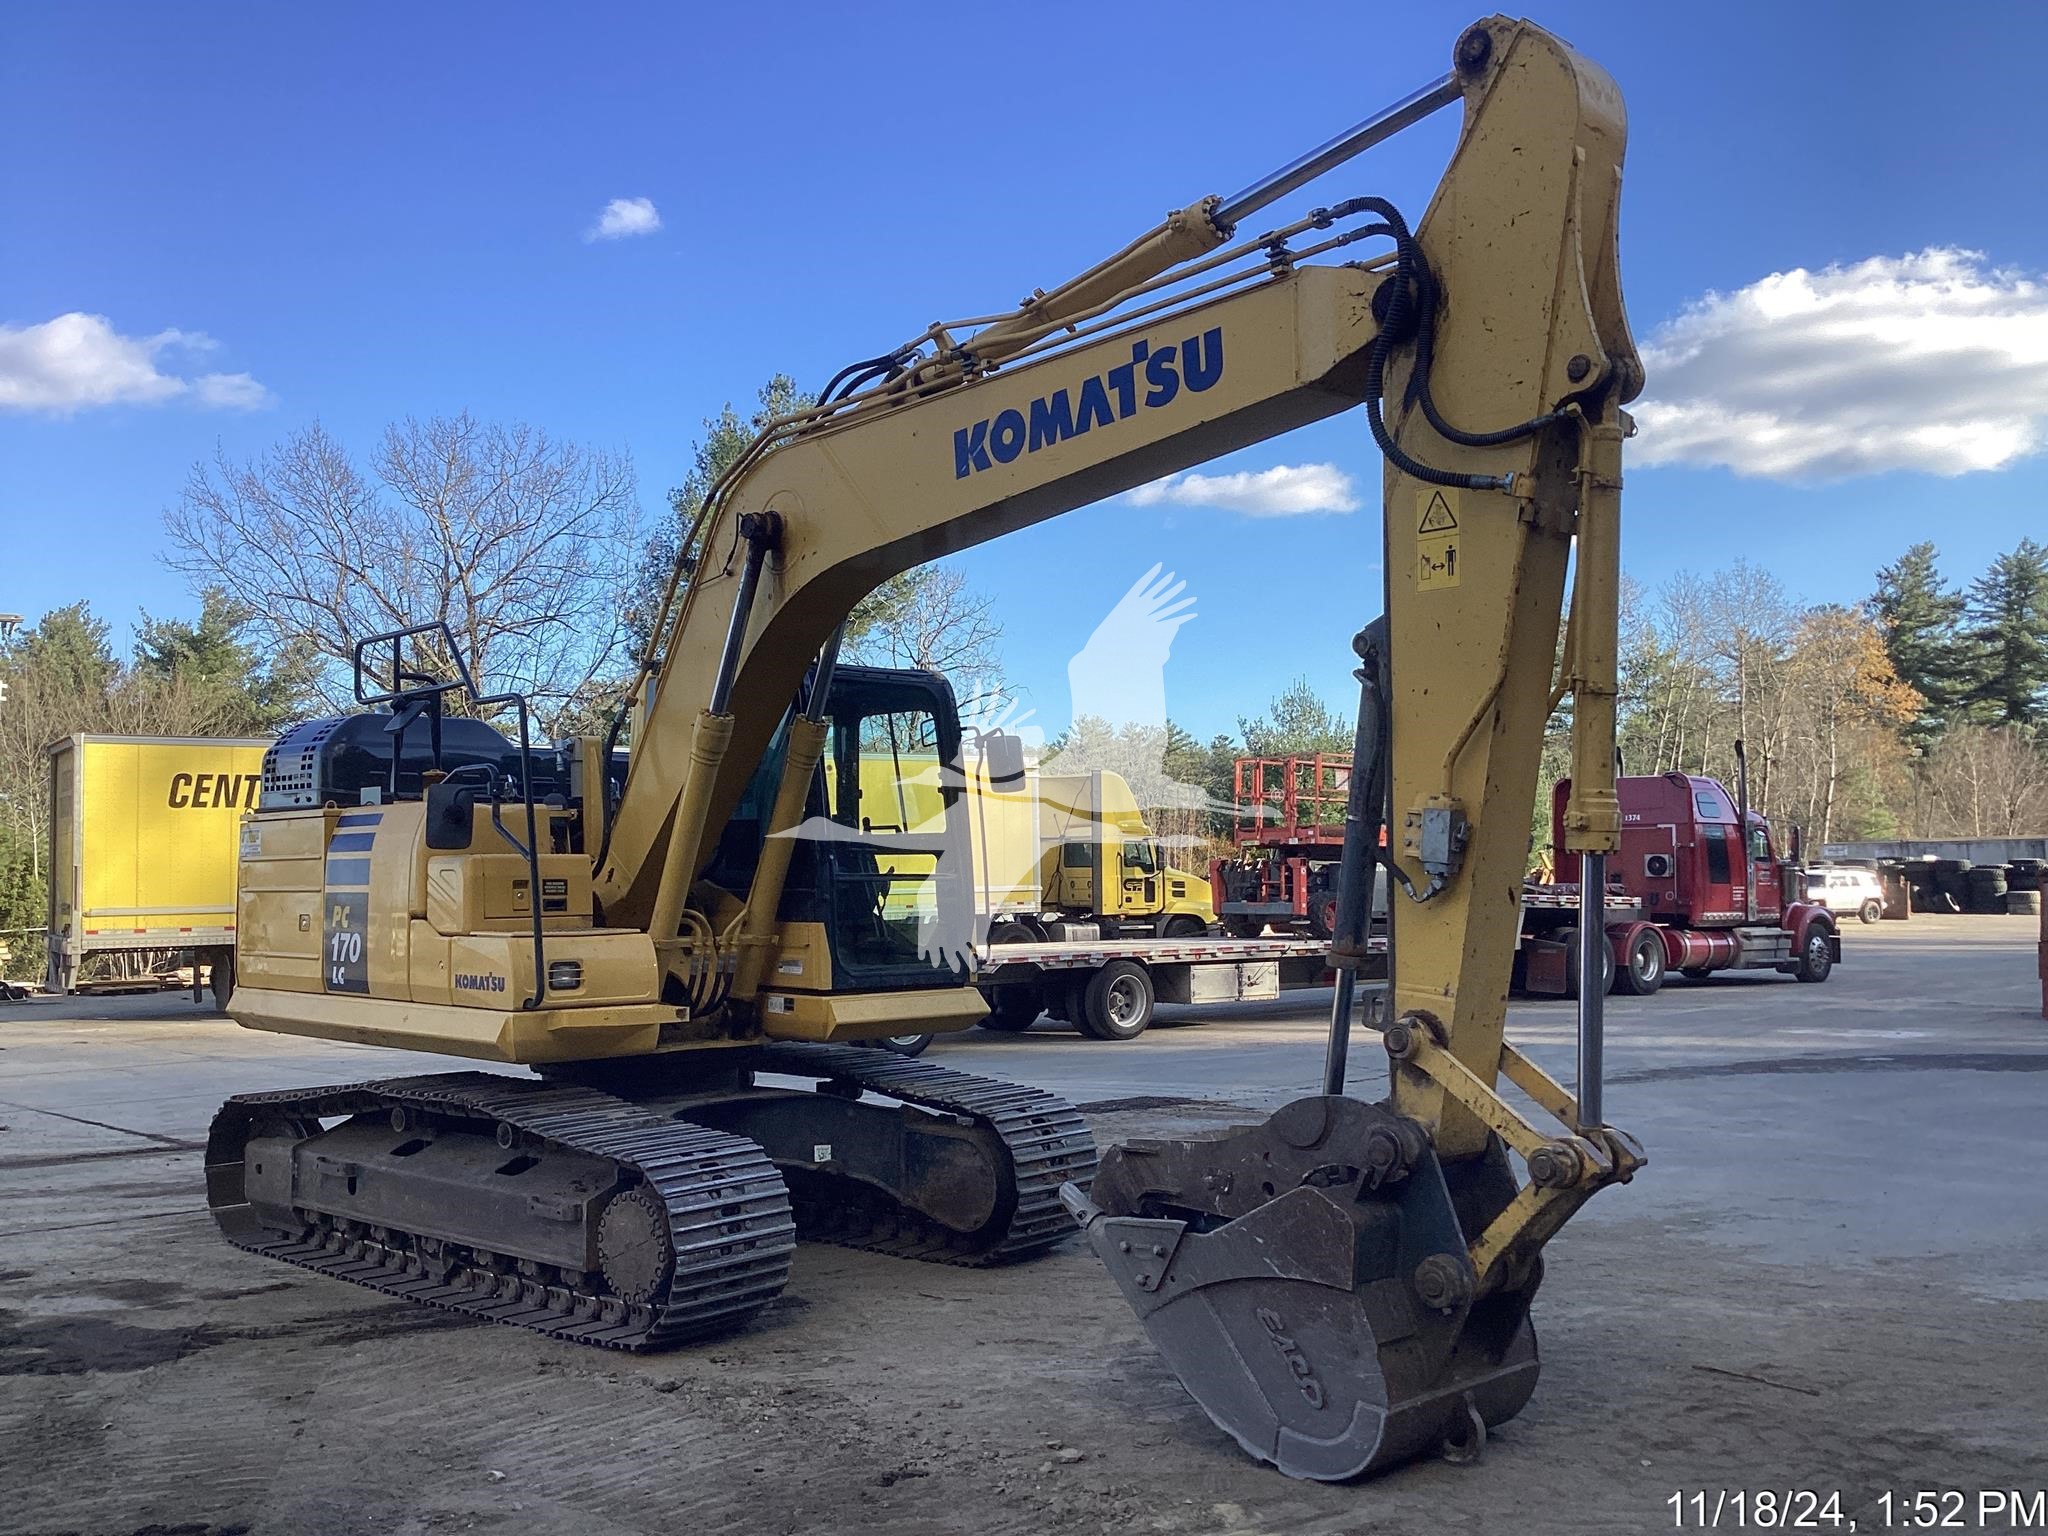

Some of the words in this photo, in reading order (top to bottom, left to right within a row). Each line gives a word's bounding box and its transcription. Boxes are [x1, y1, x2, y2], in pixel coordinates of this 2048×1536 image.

[953, 326, 1224, 480] KOMATSU
[168, 773, 262, 808] CENT
[331, 905, 351, 929] PC
[331, 932, 362, 963] 170
[332, 966, 345, 985] LC
[454, 971, 506, 993] KOMATSU
